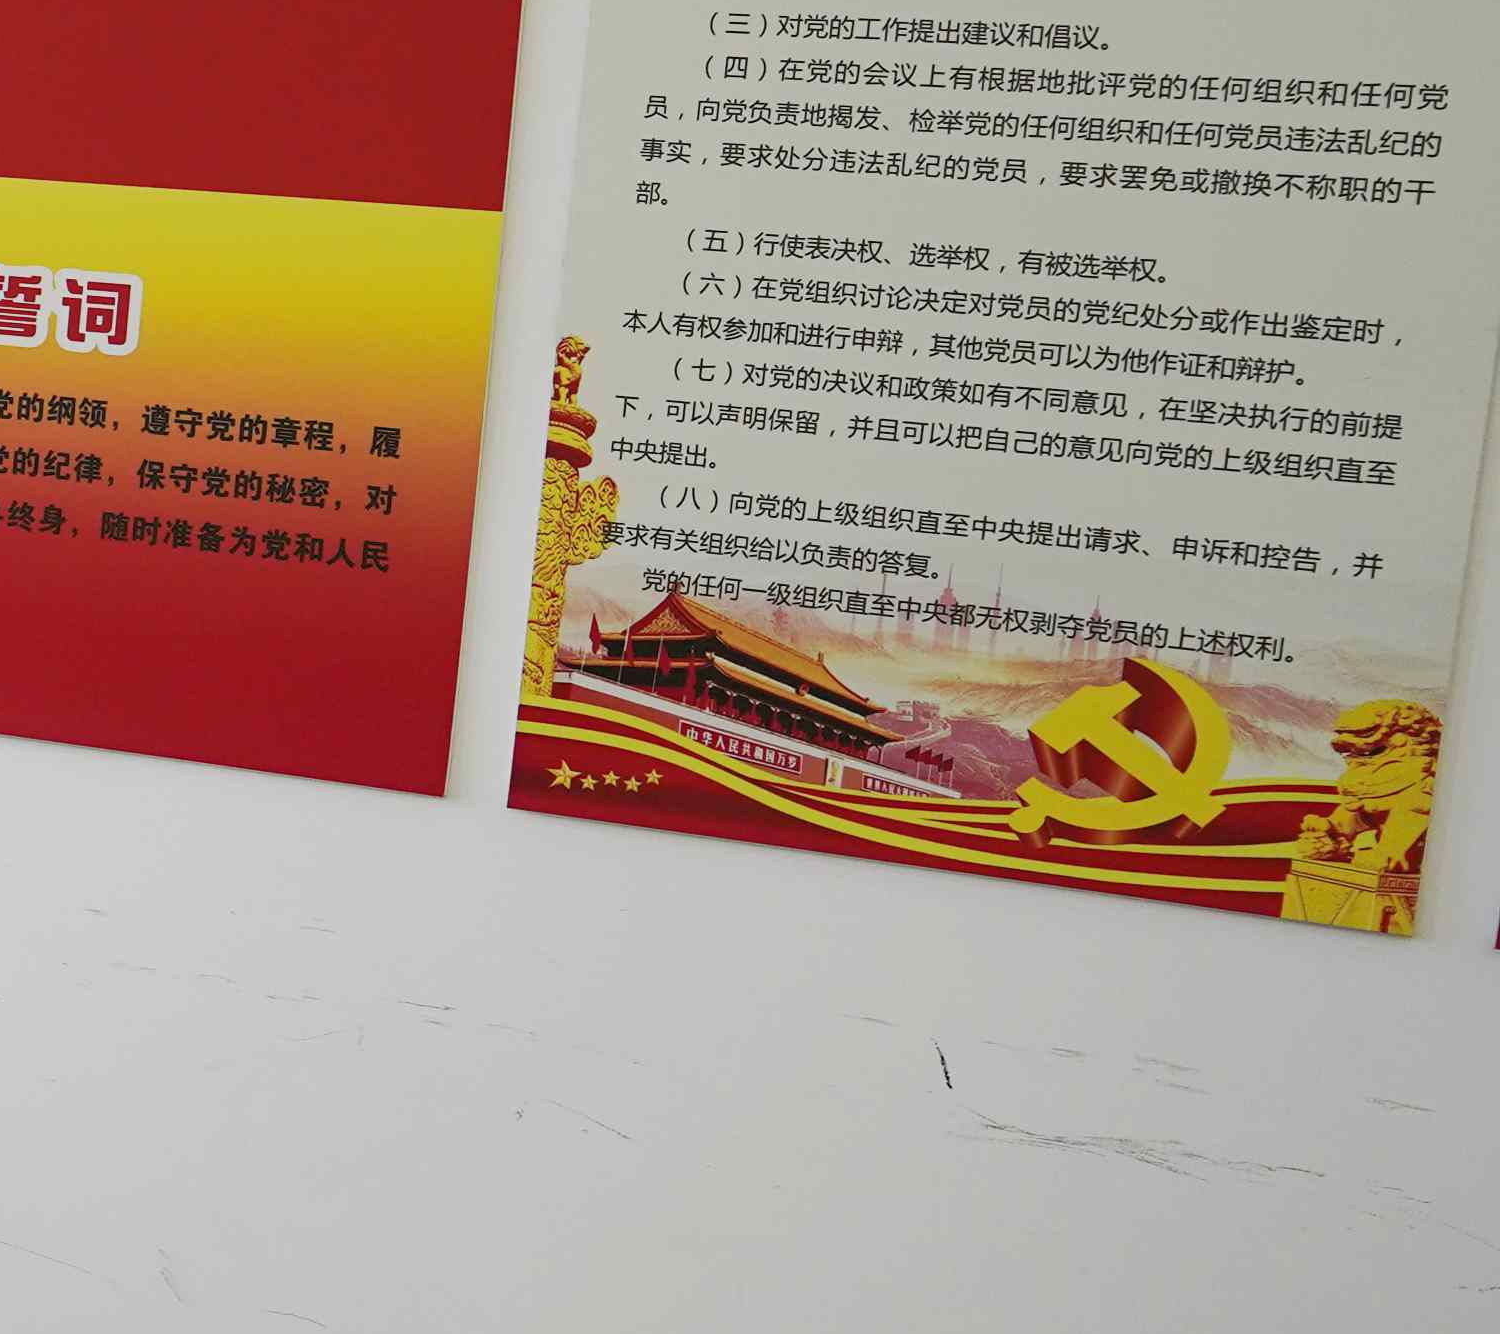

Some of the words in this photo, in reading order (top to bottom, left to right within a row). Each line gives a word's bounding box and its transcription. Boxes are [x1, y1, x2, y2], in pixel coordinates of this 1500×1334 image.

[706, 11, 1112, 50] （三）对党的工作提出建议和倡议。
[701, 55, 1451, 111] （四）在党的会议上有根据地批评党的任何组织和任何党
[643, 95, 1442, 158] 员，向党负责地揭发、检举党的任何组织和任何党员违法乱纪的
[634, 181, 671, 206] 部。
[638, 137, 1437, 206] 事实，要求处分违法乱纪的党员，要求罢免或撤换不称职的干
[684, 228, 1173, 283] （五）行使表决权、选举权，有被选举权。
[679, 270, 1406, 346] （六）在党组织讨论决定对党员的党纪处分或作出鉴定时，
[622, 310, 1310, 385] 本人有权参加和进行申辩，其他党员可以为他作证和辩护。
[667, 357, 1403, 440] （七）对党的决议和政策如有不同意见，在坚决执行的前提
[608, 437, 720, 469] 中央提出。
[614, 395, 1397, 486] 下，可以声明保留，并且可以把自己的意见向党的上级组织直至
[600, 519, 945, 580] 要求有关组织给以负责的答复。
[655, 484, 1385, 579] （八）向党的上级组织直至中央提出请求、申诉和控告，并
[639, 568, 1298, 663] 党的任何一级组织直至中央都无权剥夺党员的上述权利。
